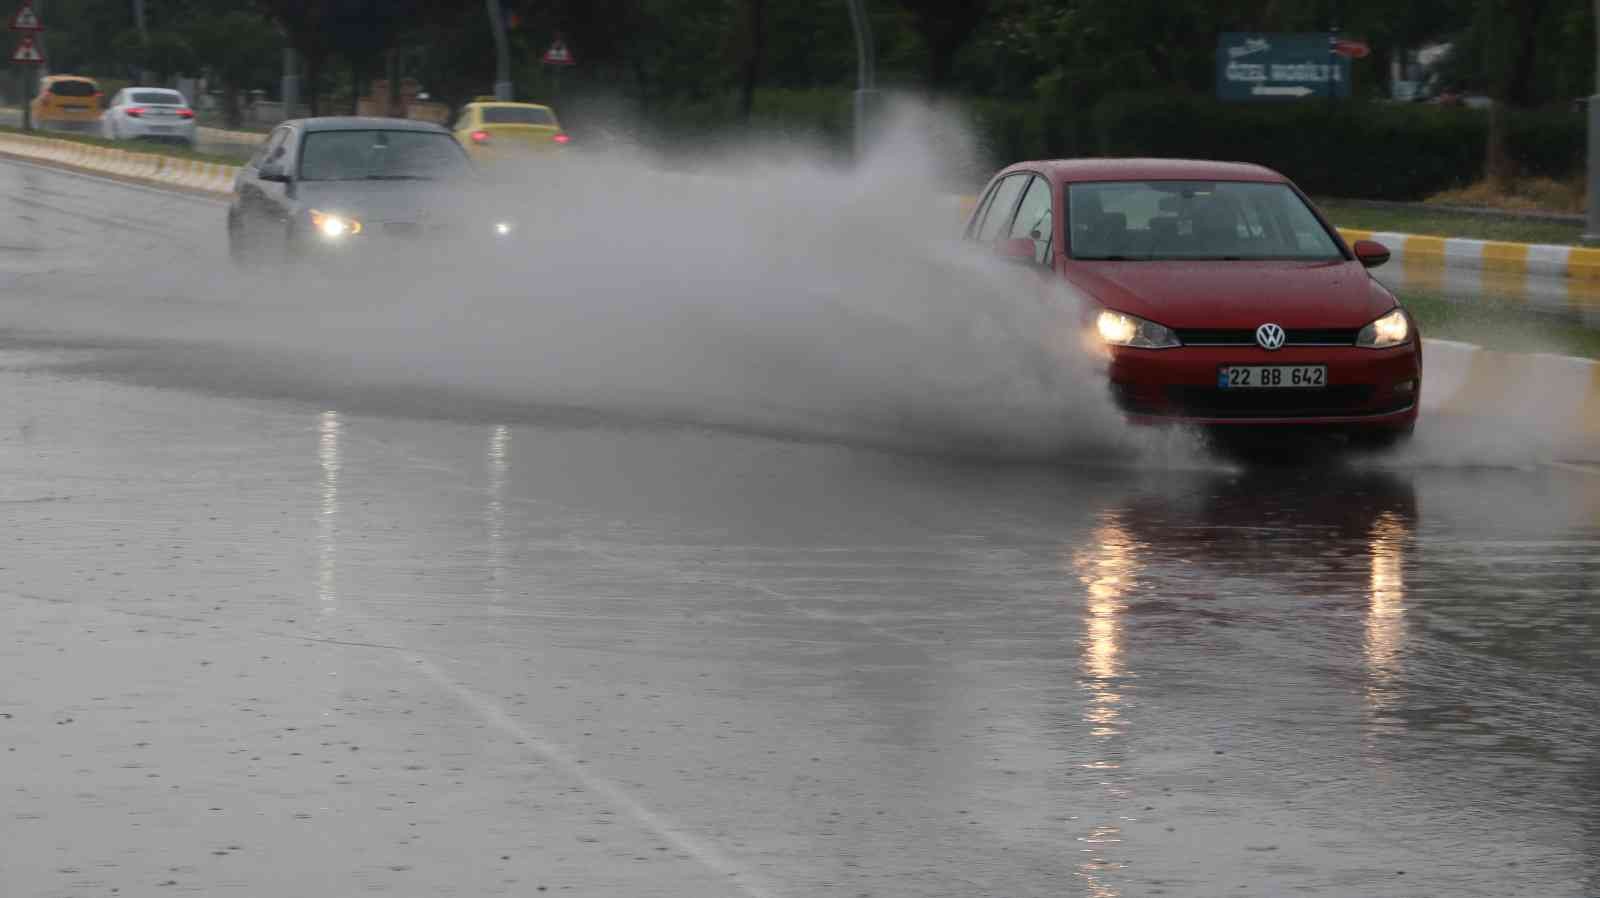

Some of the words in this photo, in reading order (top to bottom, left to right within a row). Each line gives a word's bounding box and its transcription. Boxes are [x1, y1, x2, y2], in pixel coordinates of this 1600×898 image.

[1230, 368, 1250, 385] 22
[1261, 368, 1281, 385] BB
[1292, 368, 1323, 385] 642
